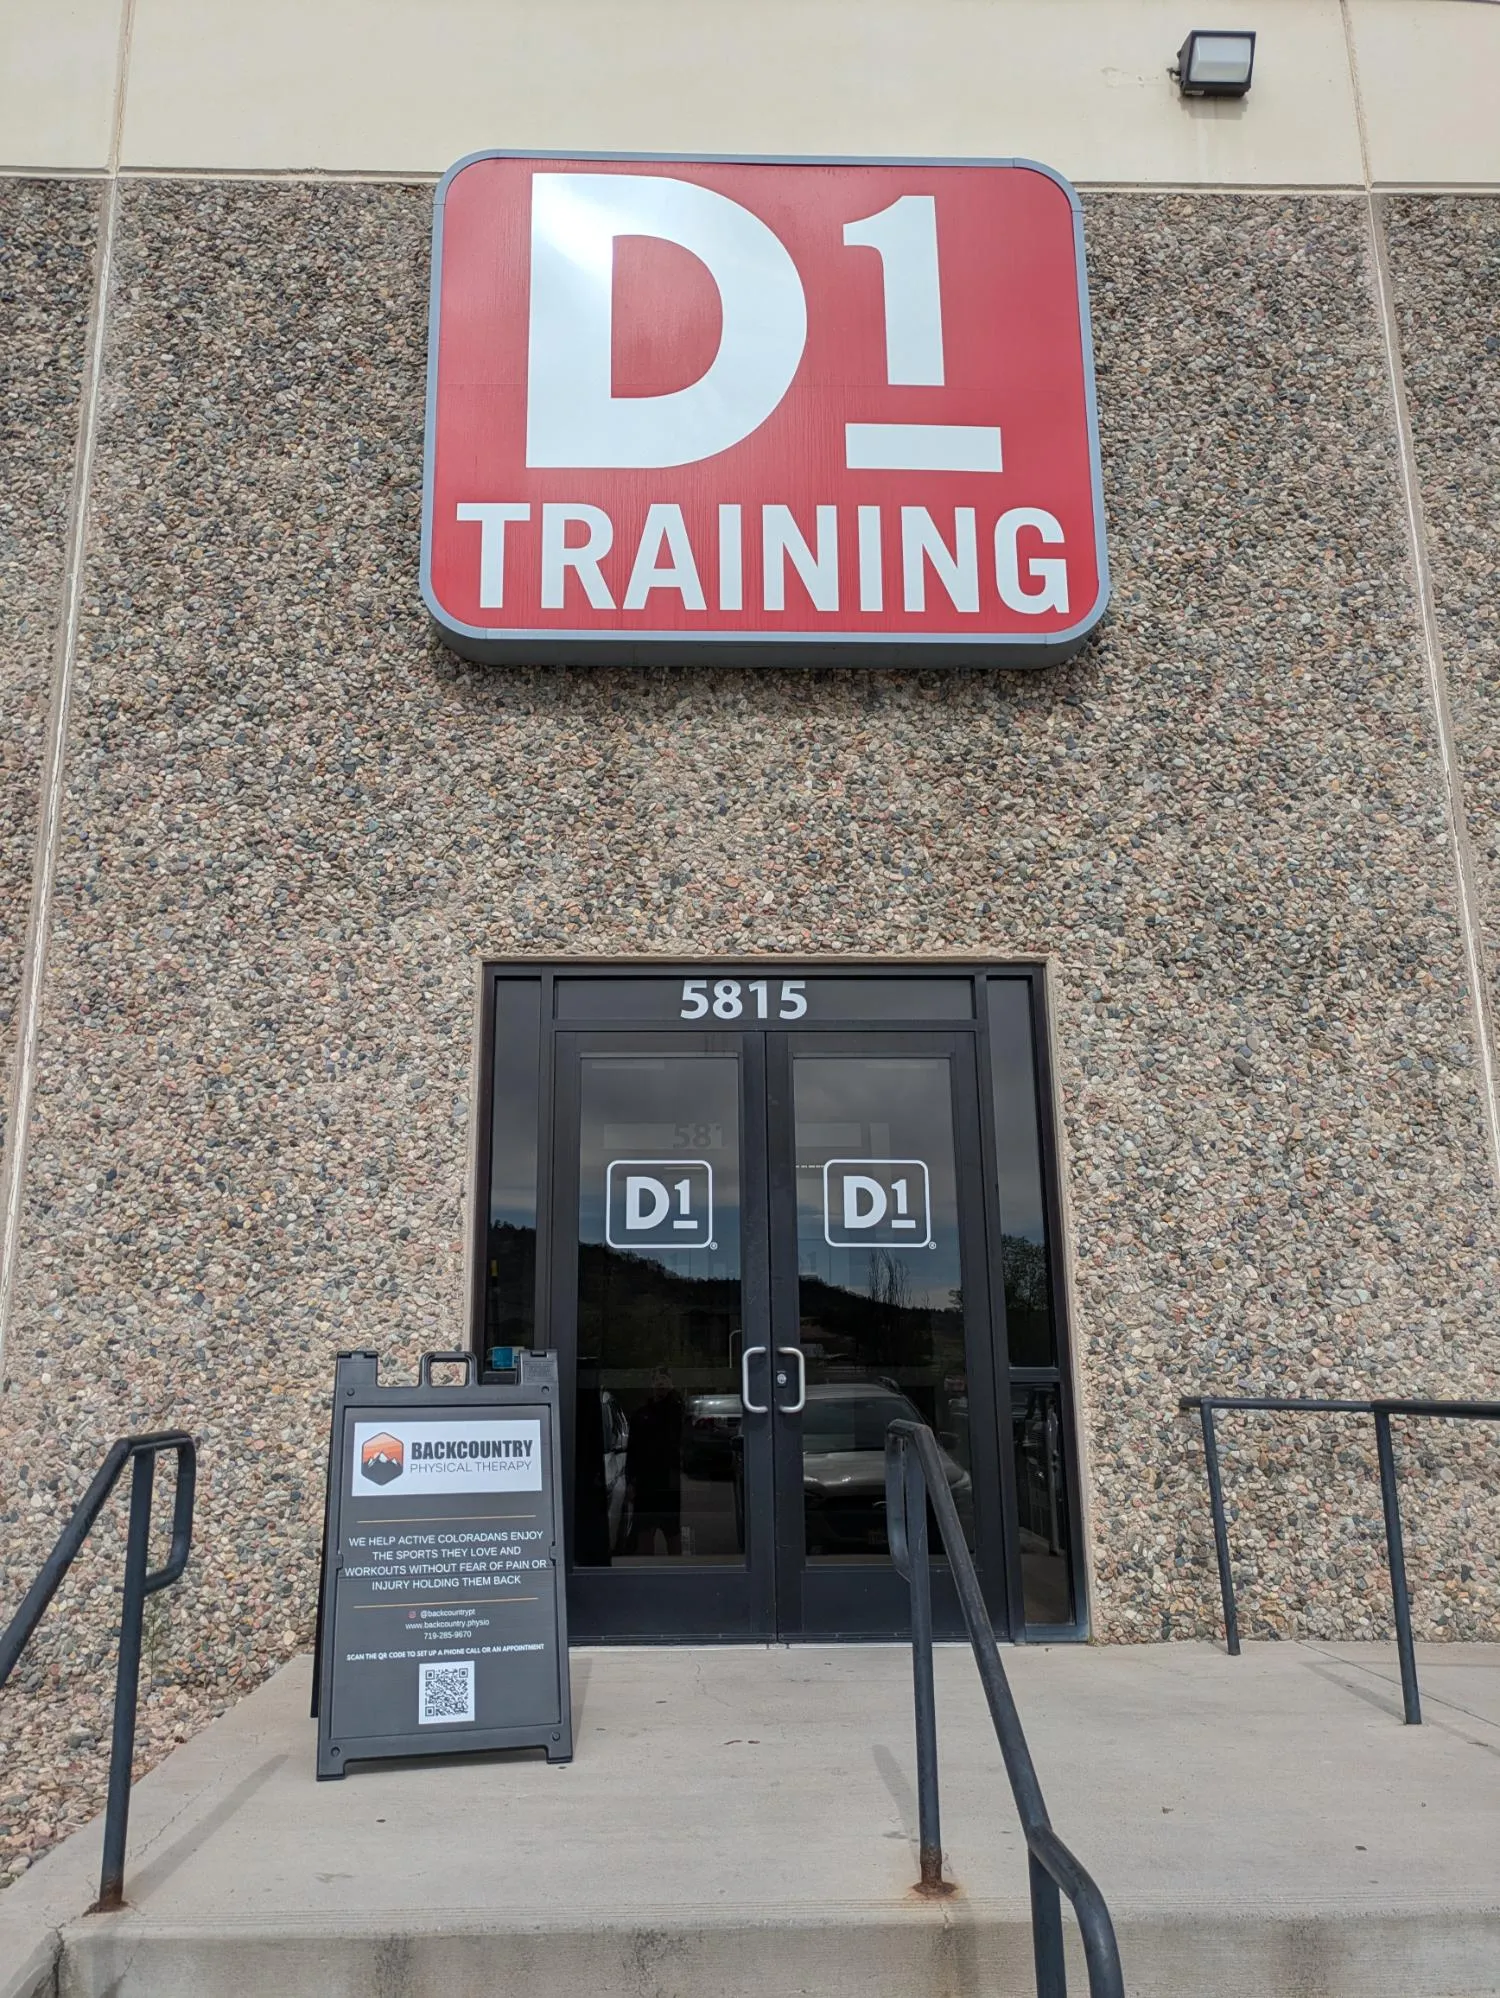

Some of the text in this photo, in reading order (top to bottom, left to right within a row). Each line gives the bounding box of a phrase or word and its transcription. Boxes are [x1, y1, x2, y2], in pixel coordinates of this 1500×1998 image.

[526, 172, 1003, 473] D1
[456, 502, 1070, 614] TRAINING
[680, 979, 807, 1020] 5815
[626, 1176, 698, 1230] D1
[843, 1175, 916, 1229] D1
[411, 1439, 533, 1460] BACKCOUNTRY
[410, 1460, 532, 1473] PHYSICAL THERAPY
[348, 1530, 544, 1547] WE HELP ACTIVE COLORADANS ENJOY
[372, 1546, 521, 1561] THE SPORTS THEY LOVE AND
[344, 1559, 547, 1577] WORKOUTS WITHOUT FEAR OF PAIN OR
[371, 1575, 521, 1591] INJURY HOLDING THEM BACK
[420, 1608, 476, 1619] @backcountrypt
[405, 1619, 490, 1630] www.backcountry.physio
[423, 1630, 472, 1640] 719-285-9670
[346, 1653, 365, 1661] SCAN
[365, 1652, 377, 1660] THE
[378, 1651, 388, 1660] QR
[388, 1650, 406, 1659] CODE
[406, 1650, 416, 1658] TO
[416, 1649, 428, 1657] SET
[437, 1648, 444, 1656] A
[444, 1647, 465, 1655] PHONE
[465, 1646, 481, 1654] CALL
[491, 1645, 502, 1653] AN
[502, 1643, 545, 1652] APPOINTMENT
